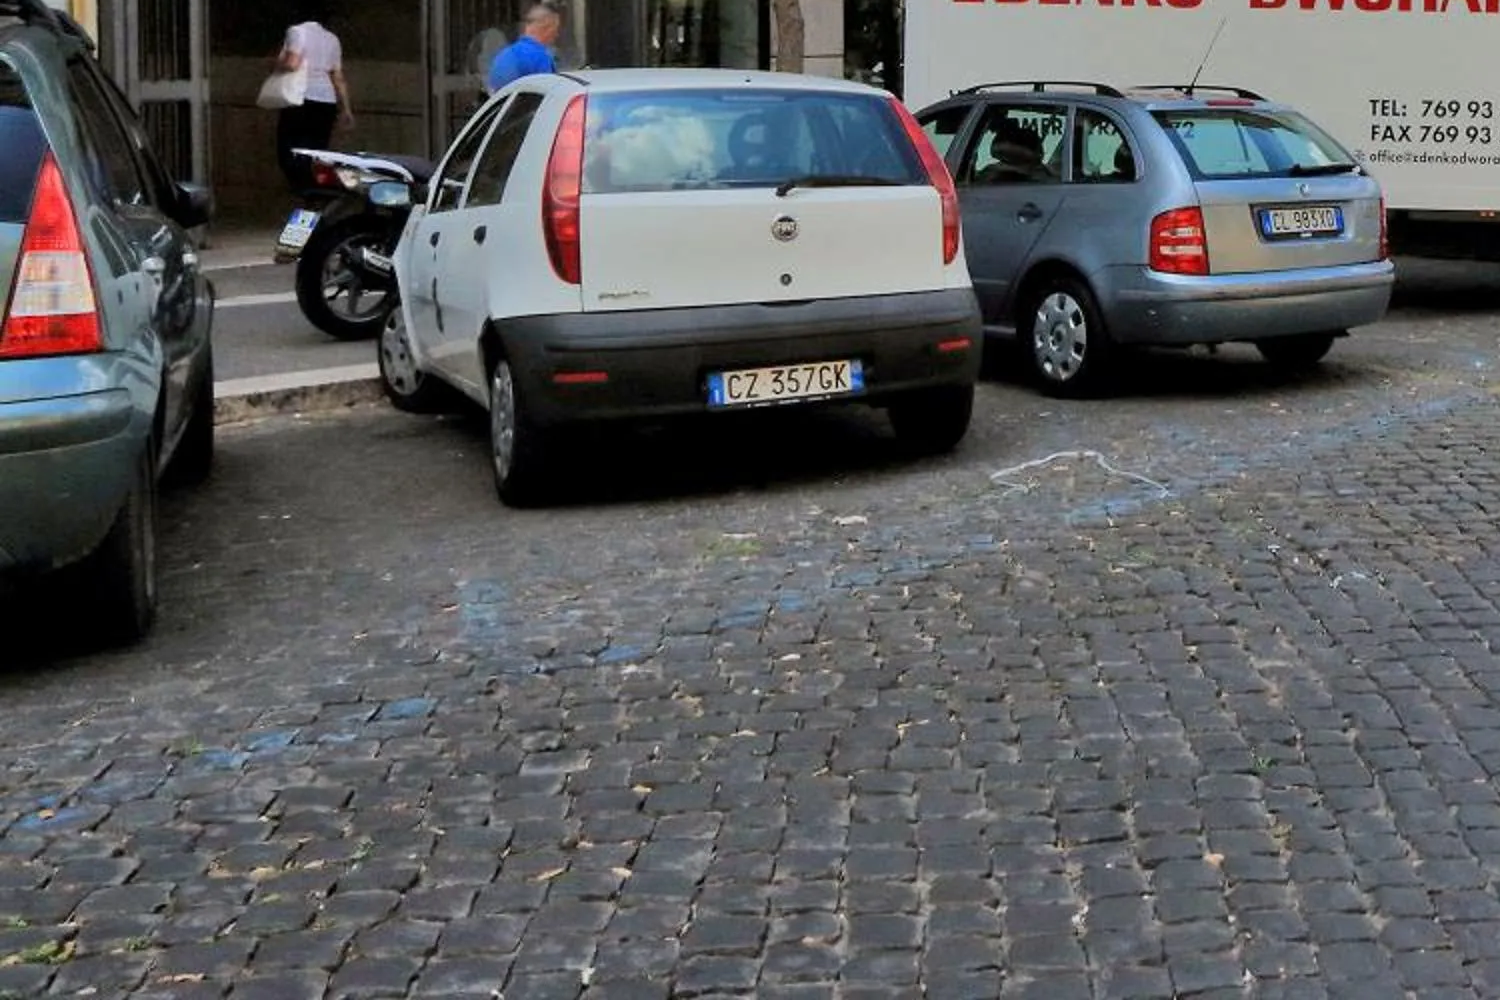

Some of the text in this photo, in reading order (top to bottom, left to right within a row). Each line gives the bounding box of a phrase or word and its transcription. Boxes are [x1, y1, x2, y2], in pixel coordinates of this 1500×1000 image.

[1369, 99, 1407, 118] TEL:
[1421, 100, 1461, 119] 769
[1467, 100, 1493, 119] 93
[1371, 124, 1412, 143] FAX
[1419, 125, 1459, 144] 769
[1465, 126, 1492, 145] 93
[727, 373, 759, 400] CZ
[770, 363, 847, 396] 357GK
